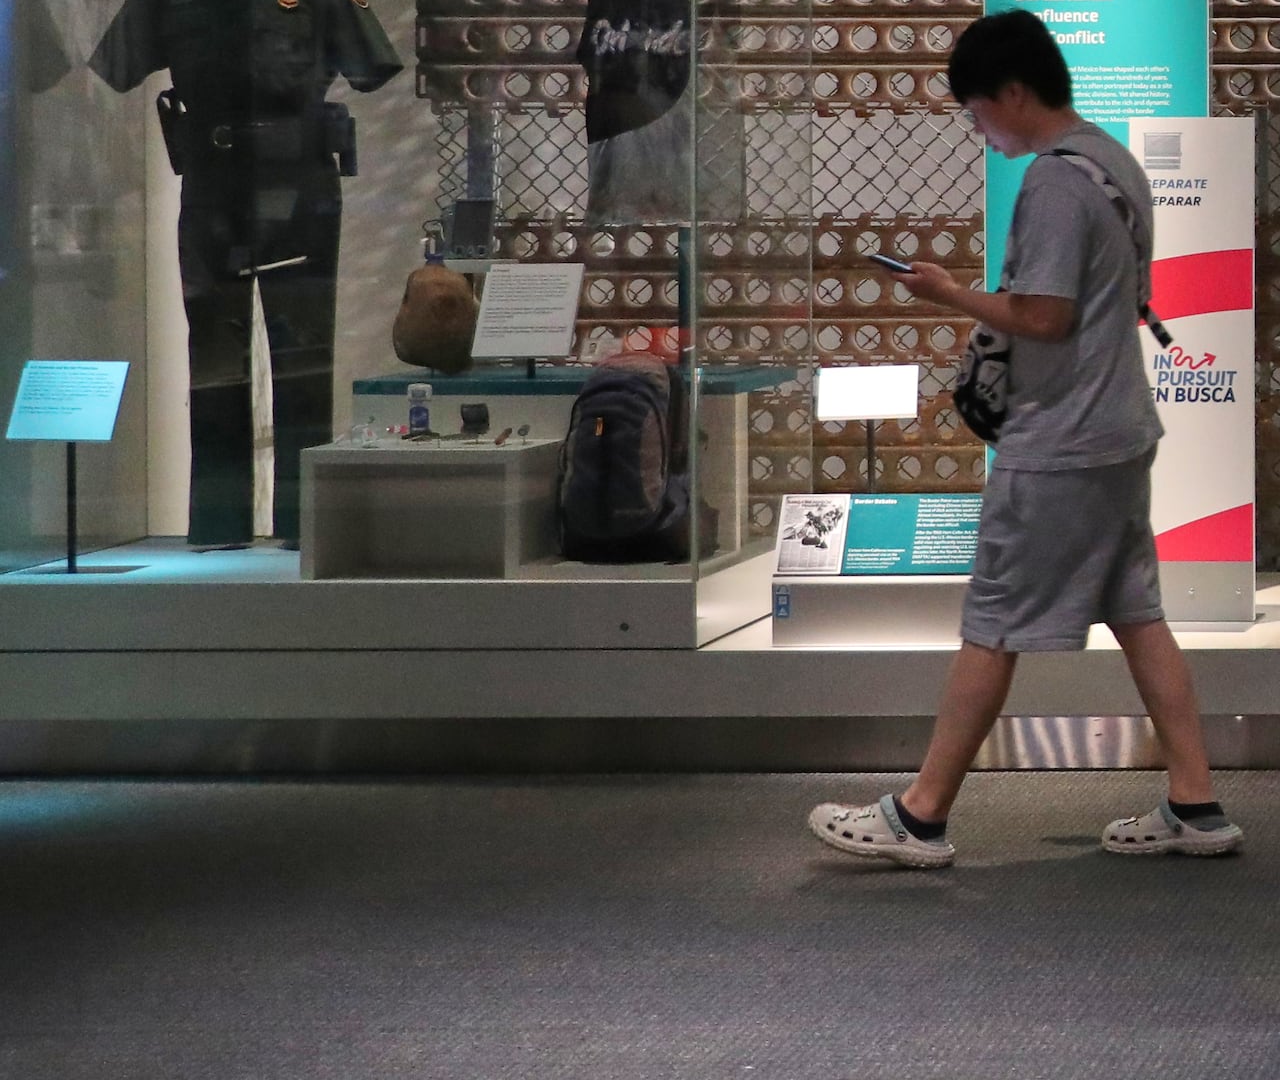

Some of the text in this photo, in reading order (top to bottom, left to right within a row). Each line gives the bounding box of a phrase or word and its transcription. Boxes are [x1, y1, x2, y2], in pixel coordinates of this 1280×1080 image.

[1034, 8, 1099, 23] nfluence
[1151, 196, 1202, 206] EPARAR
[1153, 354, 1172, 369] IN
[1157, 370, 1238, 386] PURSUIT
[1174, 387, 1236, 403] BUSCA
